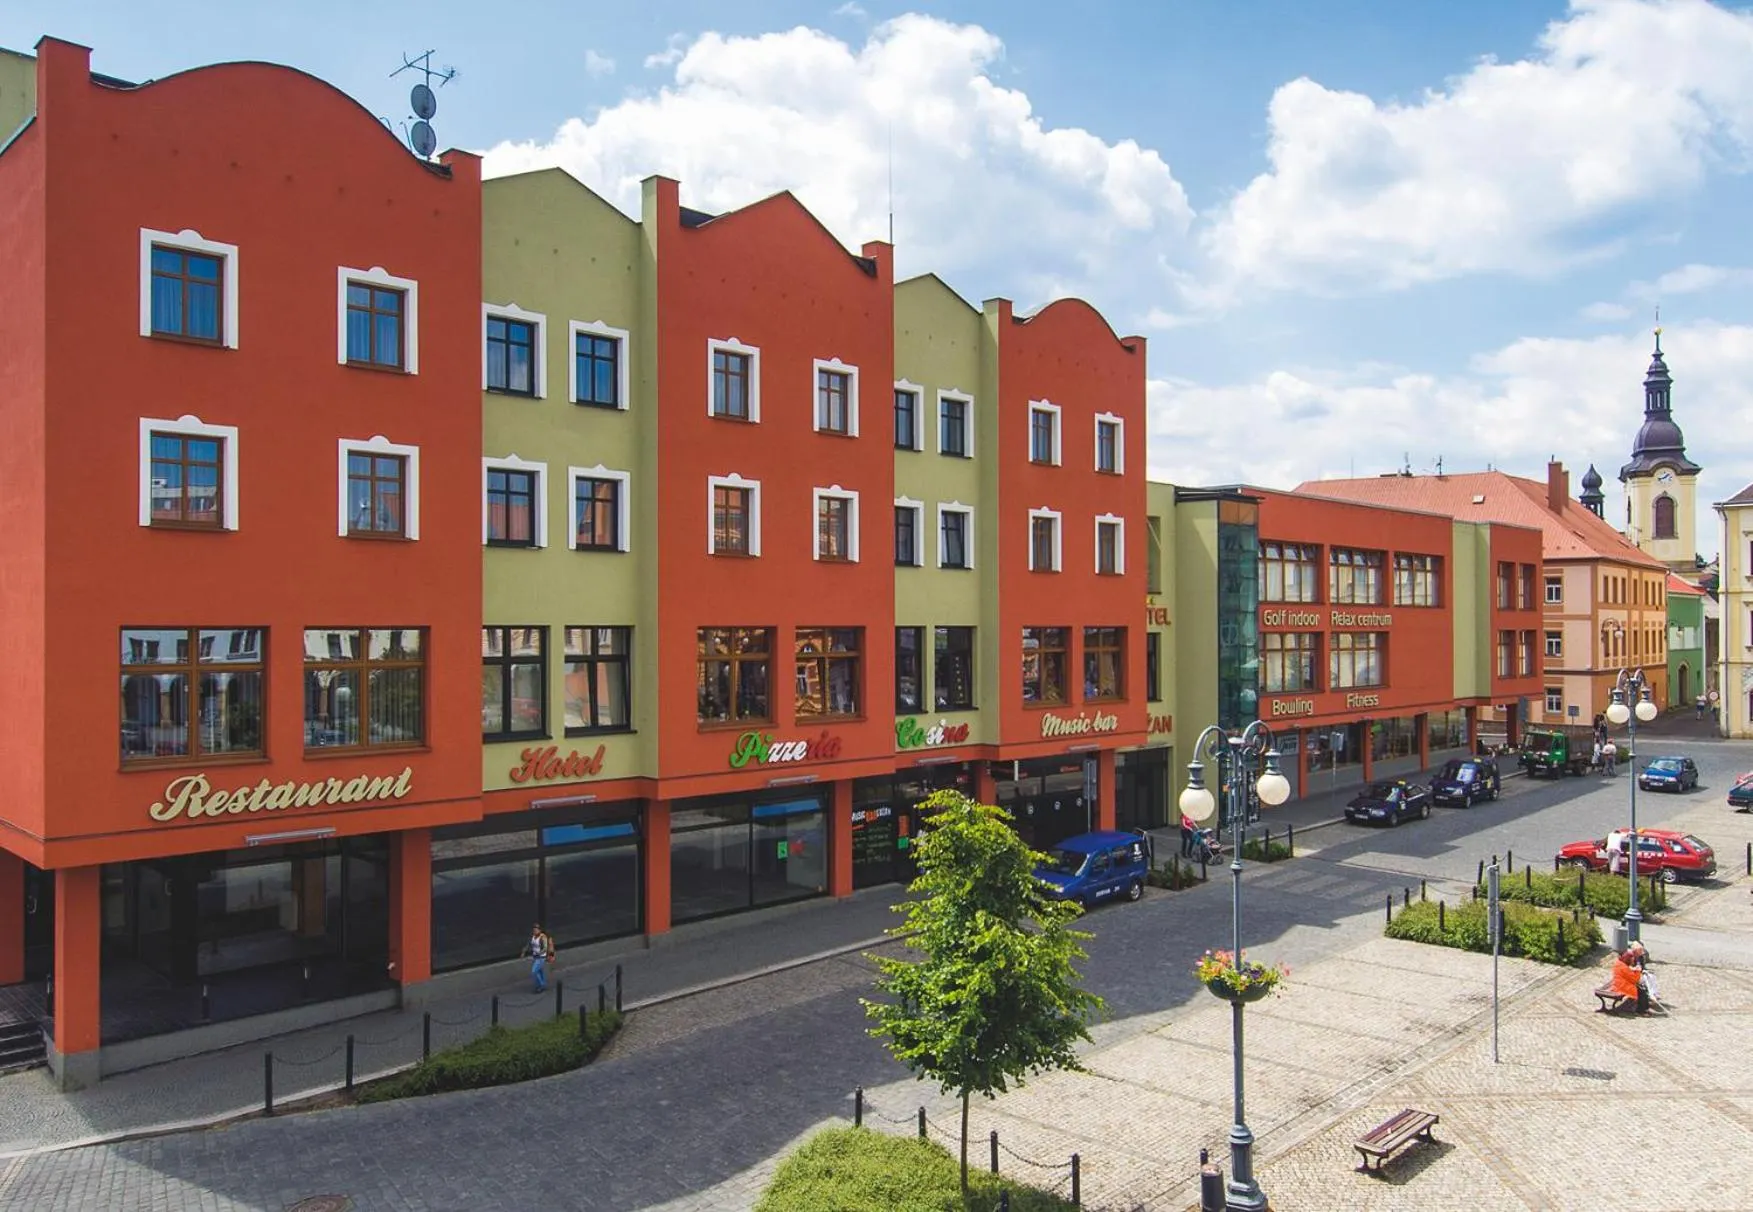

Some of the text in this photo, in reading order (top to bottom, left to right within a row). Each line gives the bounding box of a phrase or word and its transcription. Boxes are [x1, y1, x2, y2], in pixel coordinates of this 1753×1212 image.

[1263, 609, 1320, 626] Golf indoor
[1331, 610, 1393, 627] Relax centrum
[1272, 697, 1314, 715] Bowling
[1346, 693, 1379, 708] Fitness
[1041, 710, 1118, 738] Music bar
[729, 729, 843, 768] Pizzeria
[509, 743, 606, 783] Hotel
[149, 766, 413, 822] Restaurant
